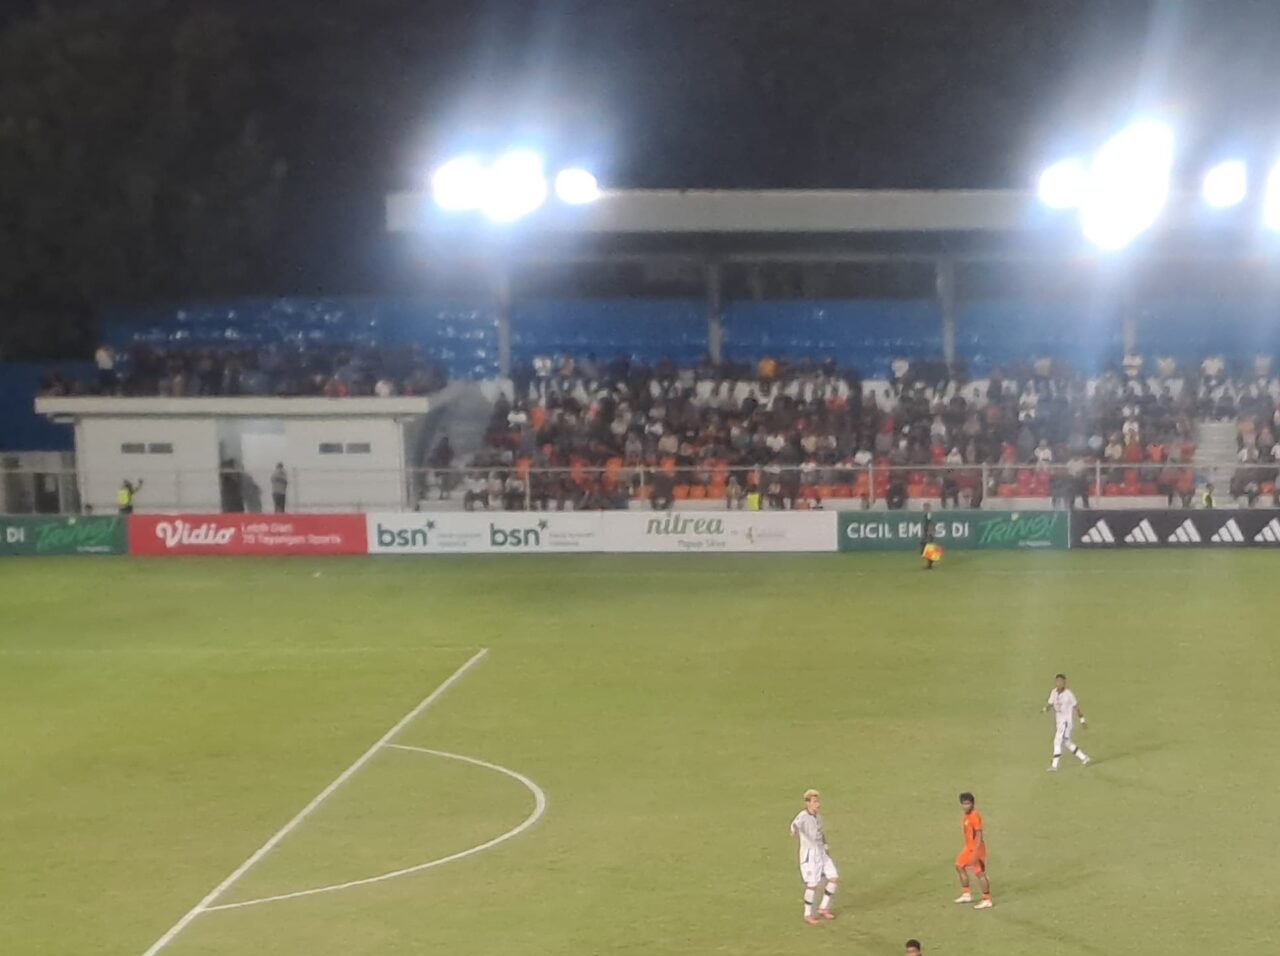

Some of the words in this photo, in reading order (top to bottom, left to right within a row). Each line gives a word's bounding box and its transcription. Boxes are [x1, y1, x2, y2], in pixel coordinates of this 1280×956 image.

[7, 527, 24, 543] DI
[156, 520, 235, 548] Vidio
[377, 523, 428, 547] bsn
[490, 523, 540, 547] bsn
[646, 512, 724, 535] nitrea
[847, 523, 892, 538] CICIL
[898, 522, 946, 538] EMS
[952, 522, 969, 538] DI
